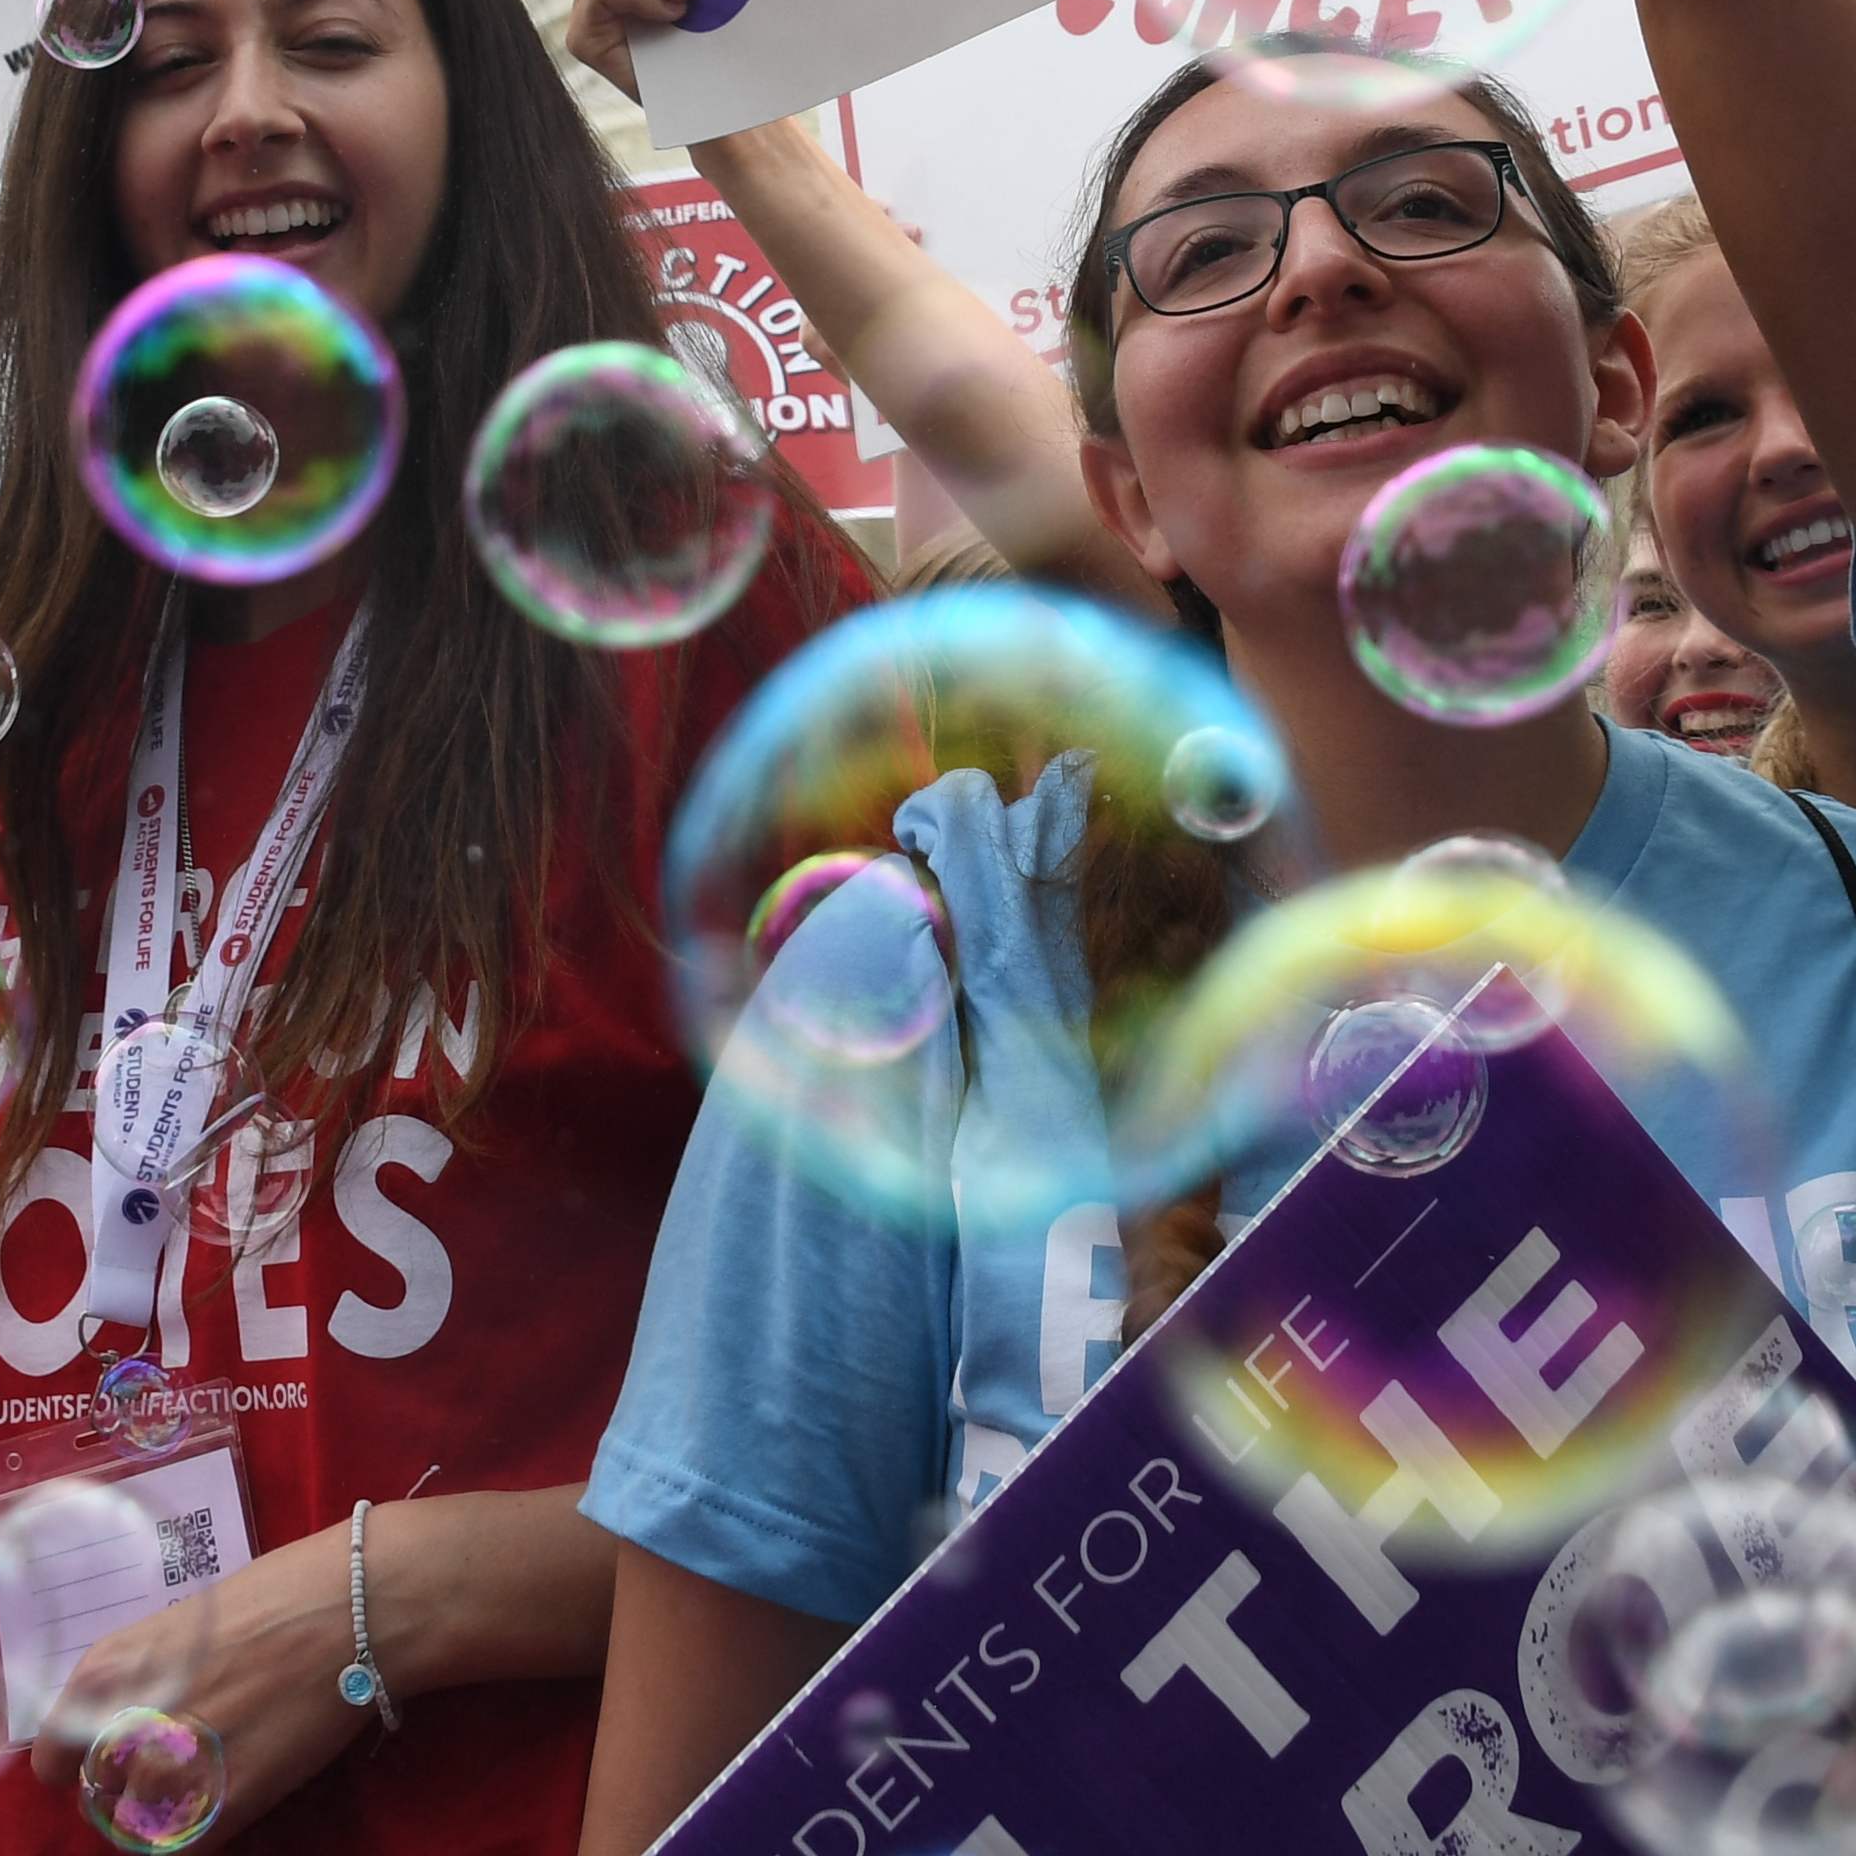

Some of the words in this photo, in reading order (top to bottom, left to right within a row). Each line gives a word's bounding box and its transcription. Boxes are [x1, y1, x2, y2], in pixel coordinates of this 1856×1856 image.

[138, 901, 154, 933] FOR
[139, 816, 162, 899] STUDENTS
[236, 844, 282, 930] STUDENTS
[275, 808, 299, 843] FOR
[293, 770, 316, 808] LIFE
[135, 935, 152, 972] LIFE
[137, 1088, 183, 1184] STUDENTS
[174, 1046, 198, 1084] FOR
[190, 1003, 216, 1044] LIFE
[1033, 1455, 1204, 1636] FOR
[1190, 1292, 1350, 1468] LIFE
[1121, 1226, 1646, 1758] THE
